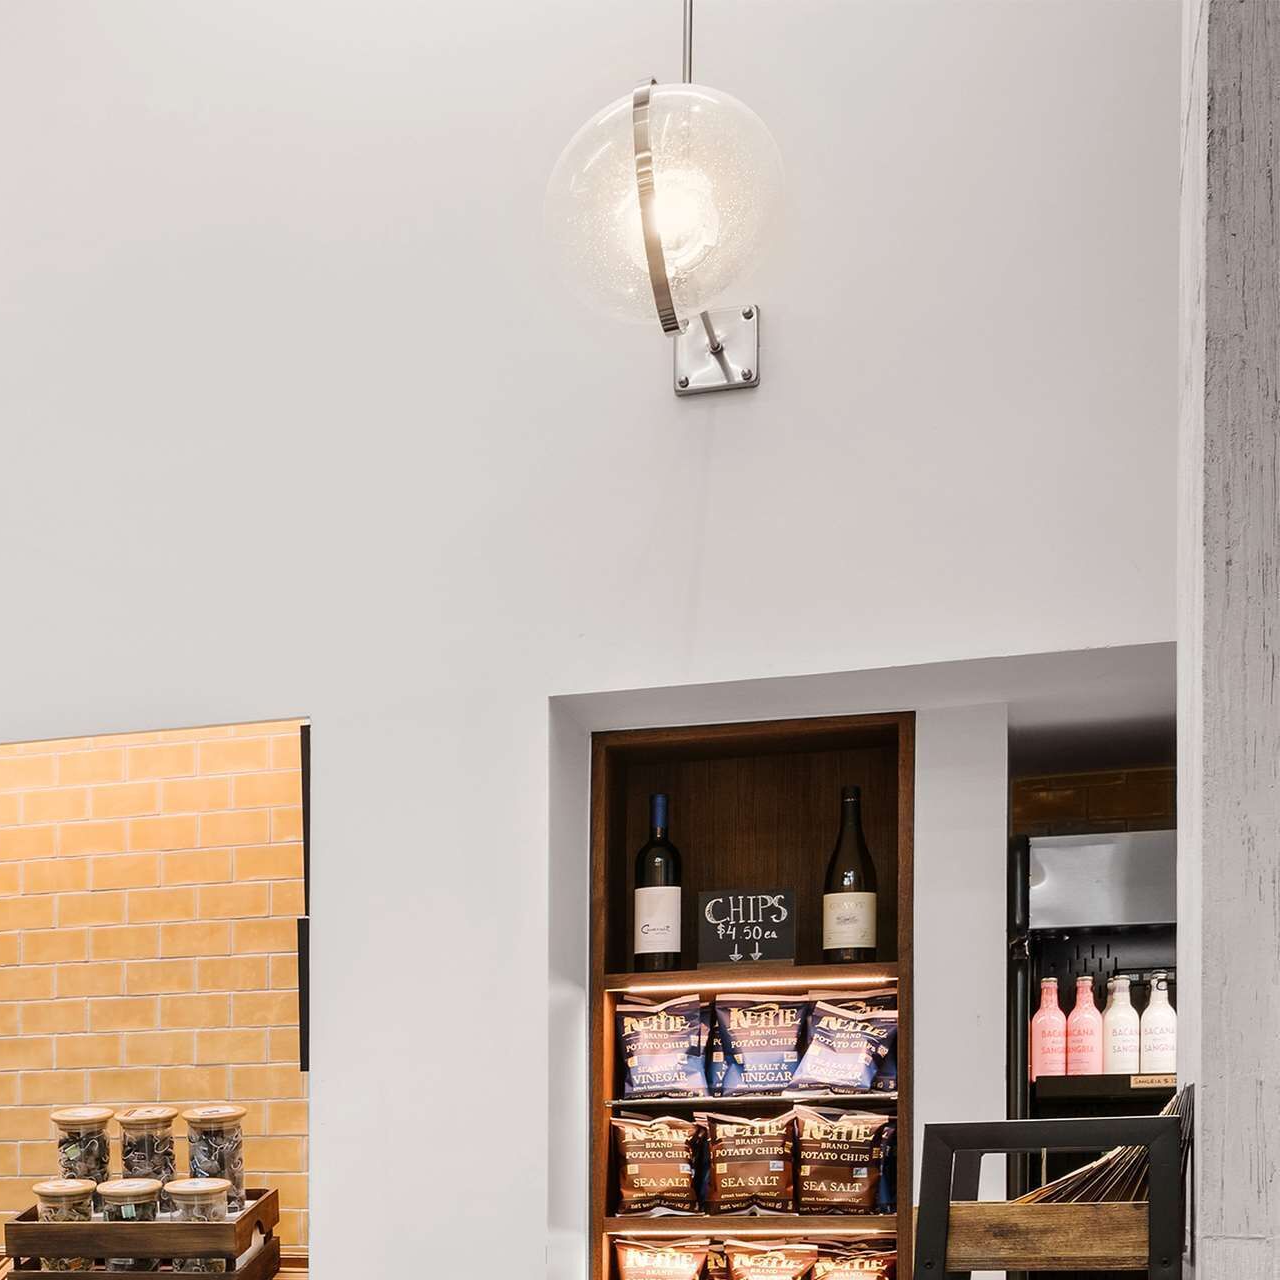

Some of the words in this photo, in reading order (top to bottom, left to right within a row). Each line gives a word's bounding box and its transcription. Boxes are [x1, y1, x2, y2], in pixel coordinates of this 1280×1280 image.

[705, 895, 788, 924] CHIPS
[717, 922, 762, 940] $4.50
[764, 930, 778, 939] ea
[728, 1003, 802, 1030] KETTLE
[750, 1029, 778, 1037] BRAND
[836, 1032, 862, 1040] BRAND
[626, 1041, 662, 1053] POTATO
[662, 1041, 690, 1049] CHIPS
[731, 1038, 769, 1048] POTATO
[770, 1038, 797, 1047] CHIPS
[813, 1033, 849, 1049] POTATO
[632, 1071, 688, 1084] VINEGAR
[735, 1137, 763, 1146] BRAND
[820, 1142, 850, 1150] BRAND
[626, 1151, 663, 1160] POTATO
[715, 1147, 753, 1158] POTATO
[755, 1146, 784, 1155] CHIPS
[800, 1150, 838, 1161] POTATO
[840, 1152, 870, 1162] CHIPS
[633, 1178, 657, 1188] SEA
[659, 1177, 690, 1188] SALT
[721, 1177, 745, 1189] SEA
[748, 1175, 779, 1187] SALT
[802, 1181, 827, 1191] SEA
[829, 1182, 862, 1193] SALT
